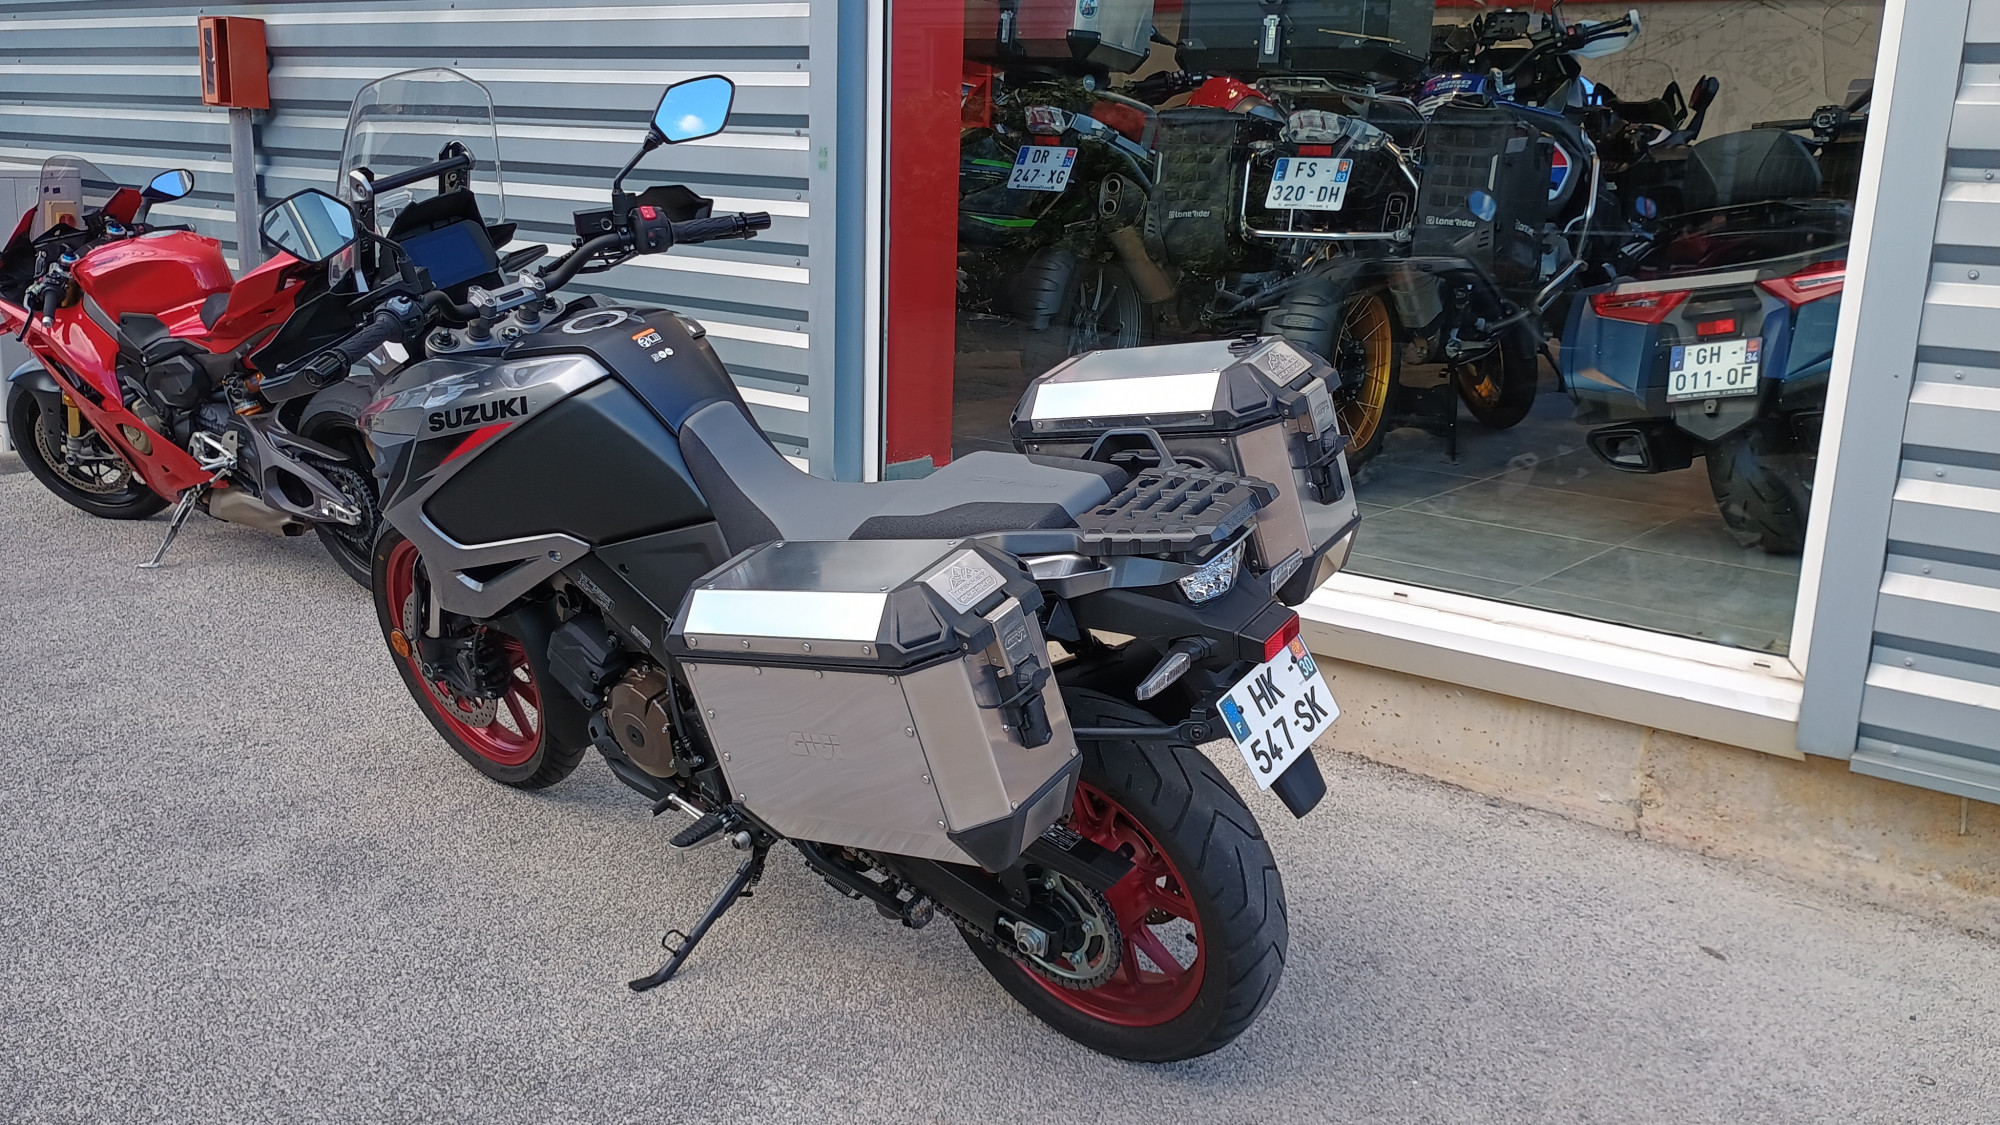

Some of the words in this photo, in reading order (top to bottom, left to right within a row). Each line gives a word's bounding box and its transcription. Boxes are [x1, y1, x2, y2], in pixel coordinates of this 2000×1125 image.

[1031, 149, 1050, 164] DR
[1013, 168, 1066, 185] 247-XG
[1275, 171, 1284, 180] F
[1295, 161, 1318, 179] FS
[1335, 172, 1347, 182] 83
[1272, 185, 1341, 204] 320-DH
[1696, 345, 1722, 365] GH
[428, 395, 529, 432] SUZUKI
[1298, 655, 1314, 677] 30
[1246, 666, 1286, 718] HK
[1235, 721, 1243, 735] F
[1250, 685, 1329, 775] 547-SK
